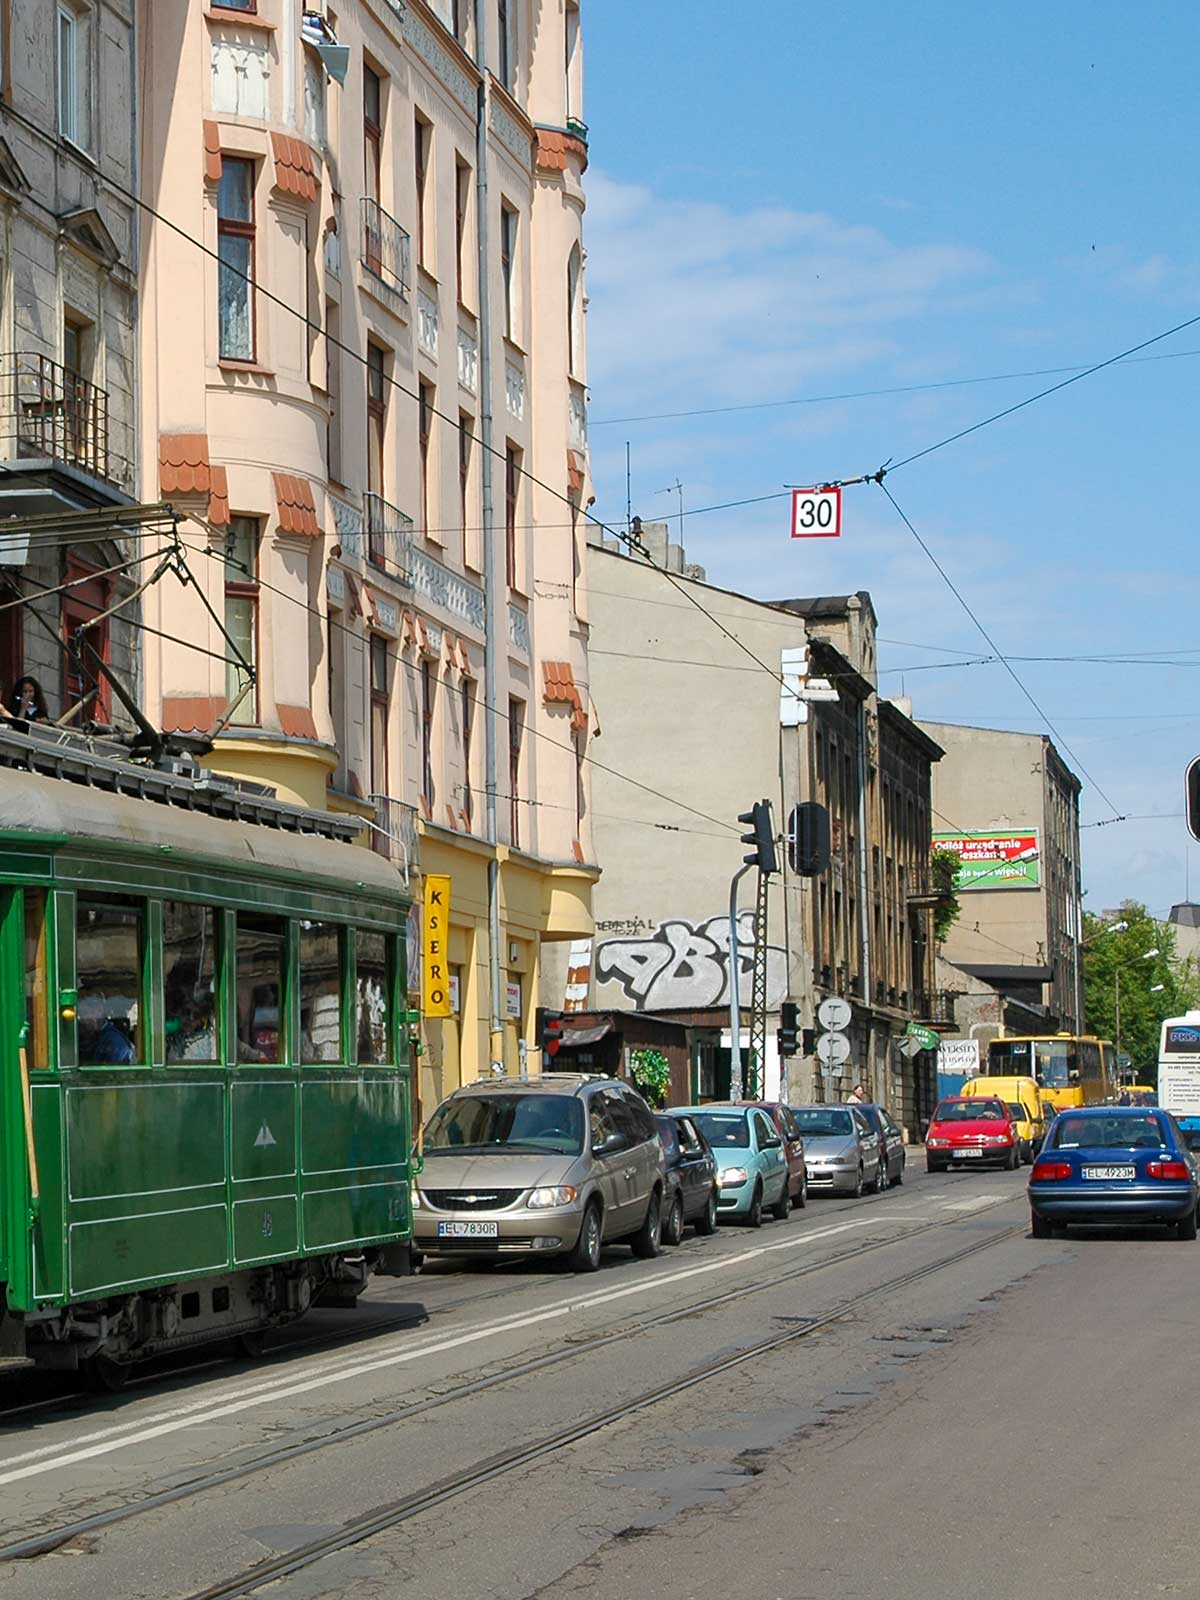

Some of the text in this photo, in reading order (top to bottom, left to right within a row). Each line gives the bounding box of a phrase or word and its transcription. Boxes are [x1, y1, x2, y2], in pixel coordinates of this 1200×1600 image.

[800, 499, 832, 528] 30
[430, 891, 444, 1004] KSERO
[445, 1223, 496, 1234] EL 7830R
